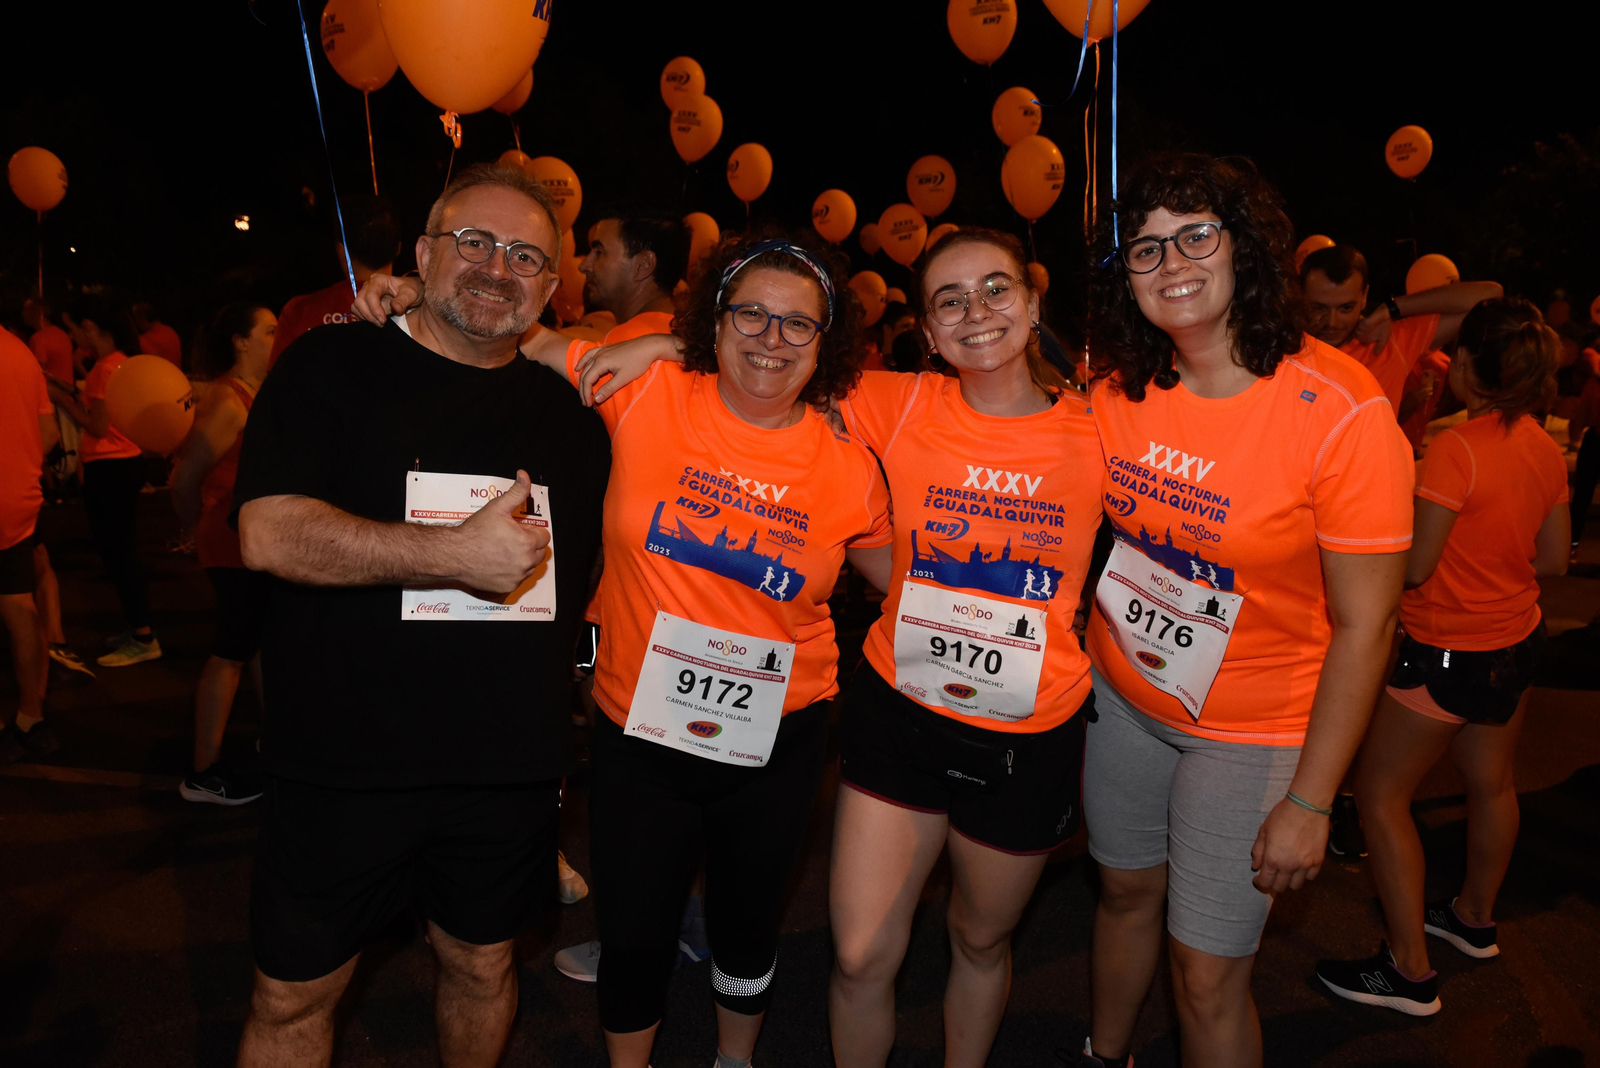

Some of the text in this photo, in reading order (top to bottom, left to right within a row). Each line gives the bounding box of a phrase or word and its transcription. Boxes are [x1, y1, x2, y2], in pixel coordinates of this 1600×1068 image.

[1138, 441, 1216, 483] XXXV
[679, 475, 689, 486] DEL
[684, 467, 740, 494] CARRERA
[962, 465, 1043, 498] XXXV
[1110, 456, 1157, 483] CARRERA
[1162, 477, 1231, 508] NOCTURNA
[689, 480, 808, 533] GUADALQUIVIR
[924, 495, 933, 507] DEL
[928, 485, 1066, 514] CARRERA NOCTURNA
[1111, 470, 1227, 524] GUADALQUIVIR
[933, 498, 1065, 528] GUADALQUIVIR
[649, 543, 671, 556] 2023
[913, 570, 935, 579] 2023
[520, 605, 550, 614] Cruzcampo
[1111, 573, 1123, 582] XXXV
[1123, 579, 1140, 592] CARRERA
[1140, 588, 1161, 605] NOCTURNA
[1161, 601, 1169, 610] DEL
[1169, 605, 1205, 623] GUADALQUIVIR
[904, 617, 918, 625] XXXV
[918, 619, 940, 629] CARRERA
[940, 624, 967, 635] NOCTURNA
[967, 630, 976, 638] DEL
[976, 632, 1014, 645] GUADALQUIVIR
[1126, 599, 1194, 648] 9176
[931, 637, 1002, 675] 9170
[1132, 632, 1175, 656] ISABEL GARCIA
[655, 647, 671, 655] XXXV
[670, 651, 692, 663] CARRERA
[693, 657, 720, 671] NOCTURNA
[720, 664, 729, 673] DEL
[729, 666, 764, 679] GUADALQUIVIR
[926, 659, 1004, 689] CARMEN GARCIA SANCHEZ
[677, 670, 753, 710] 9172
[666, 696, 752, 723] CARMEN SANCHEZ VILLALBA
[729, 750, 763, 761] Cruzcampo
